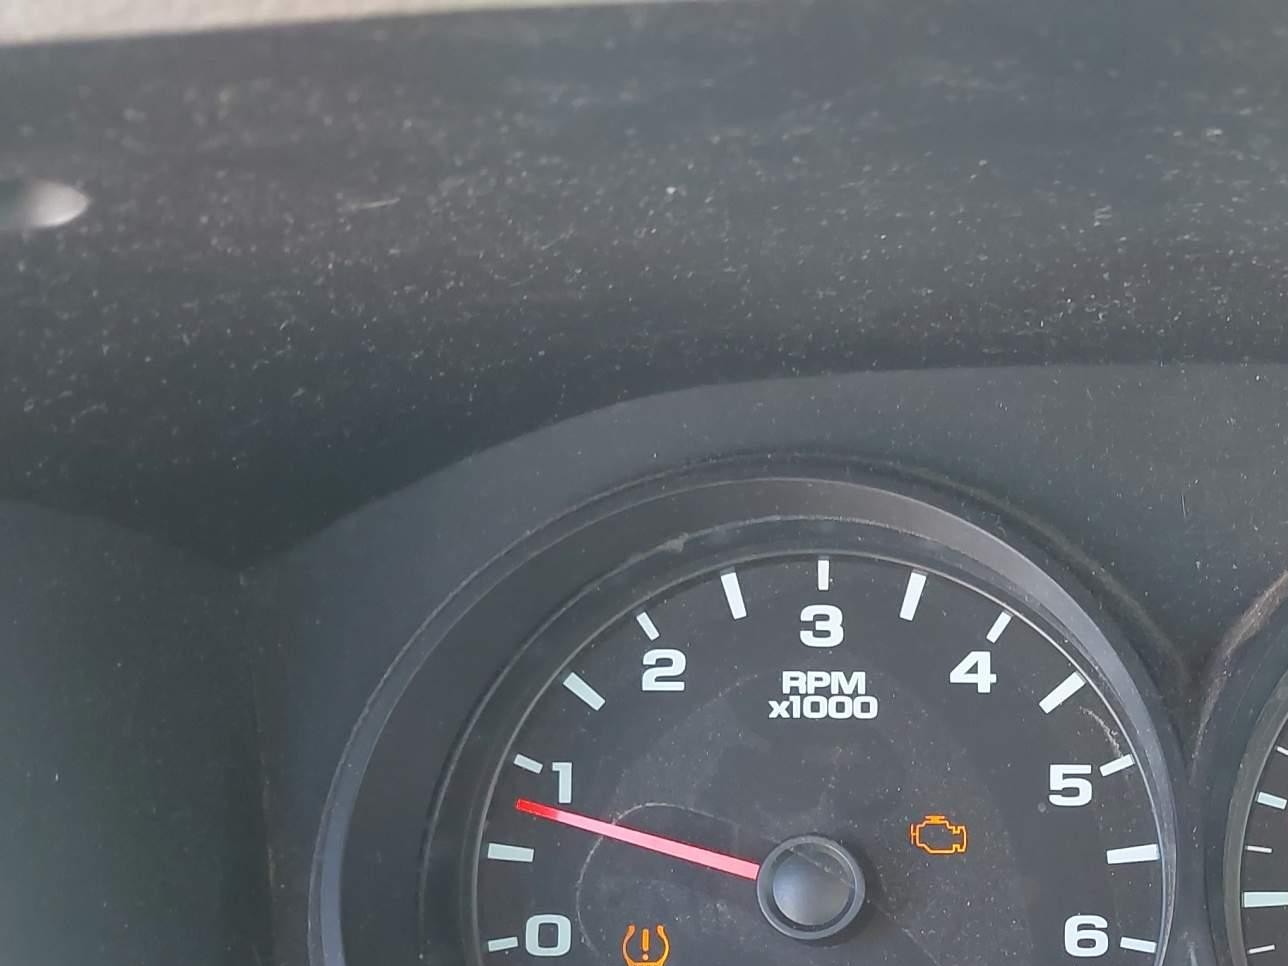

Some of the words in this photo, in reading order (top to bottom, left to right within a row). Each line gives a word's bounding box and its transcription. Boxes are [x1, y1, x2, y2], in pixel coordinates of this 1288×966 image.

[800, 604, 844, 647] 3
[642, 649, 686, 691] 2
[782, 671, 866, 694] RPM
[950, 651, 997, 693] 4
[768, 695, 878, 719] x1000
[552, 762, 572, 803] 1
[1049, 764, 1092, 806] 5
[525, 914, 572, 957] 0
[1064, 915, 1109, 957] 6
